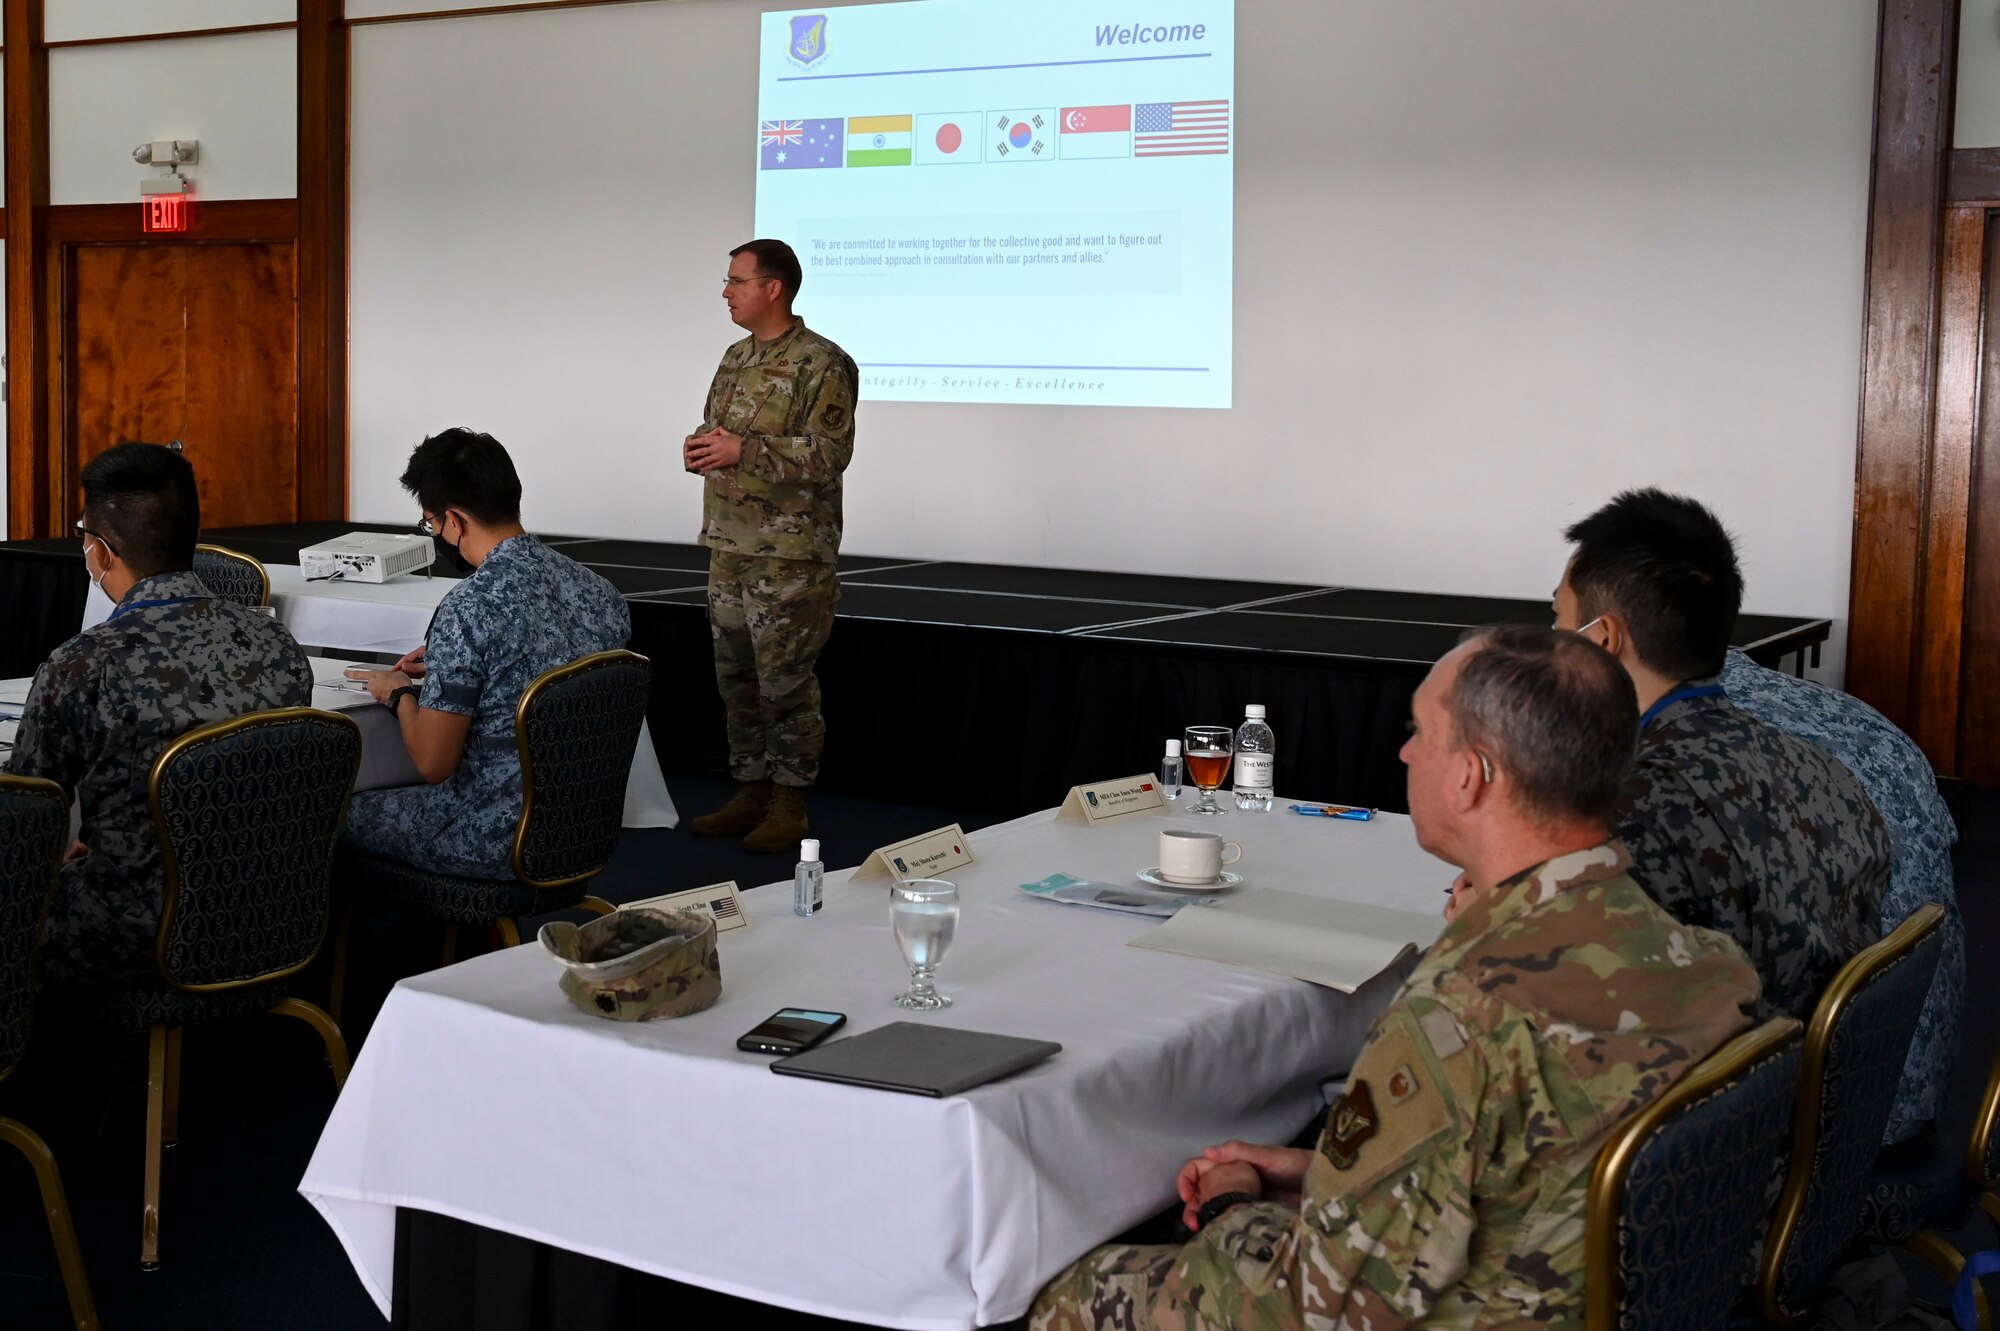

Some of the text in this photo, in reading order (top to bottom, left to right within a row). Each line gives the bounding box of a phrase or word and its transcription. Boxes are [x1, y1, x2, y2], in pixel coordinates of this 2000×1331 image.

[1095, 23, 1206, 46] Welcome
[151, 196, 179, 229] EXIT
[828, 241, 841, 250] are
[843, 238, 886, 250] committed
[887, 239, 896, 249] to
[898, 238, 930, 251] working
[932, 237, 966, 251] together
[969, 237, 981, 248] for
[983, 236, 997, 248] the
[999, 236, 1040, 248] collective
[1042, 235, 1063, 249] good
[1065, 234, 1081, 247] and
[1083, 235, 1105, 246] want
[1107, 235, 1116, 246] to
[1119, 234, 1145, 248] figure
[1147, 234, 1162, 246] out
[811, 255, 823, 266] the
[825, 255, 842, 266] best
[844, 254, 882, 266] combined
[884, 254, 921, 267] approach
[923, 254, 931, 265] in
[933, 253, 983, 265] consultation
[986, 253, 1004, 265] with
[1006, 255, 1020, 265] our
[1022, 253, 1059, 266] partners
[1061, 252, 1077, 264] and
[860, 375, 1105, 390] ntegrity Service Excellence
